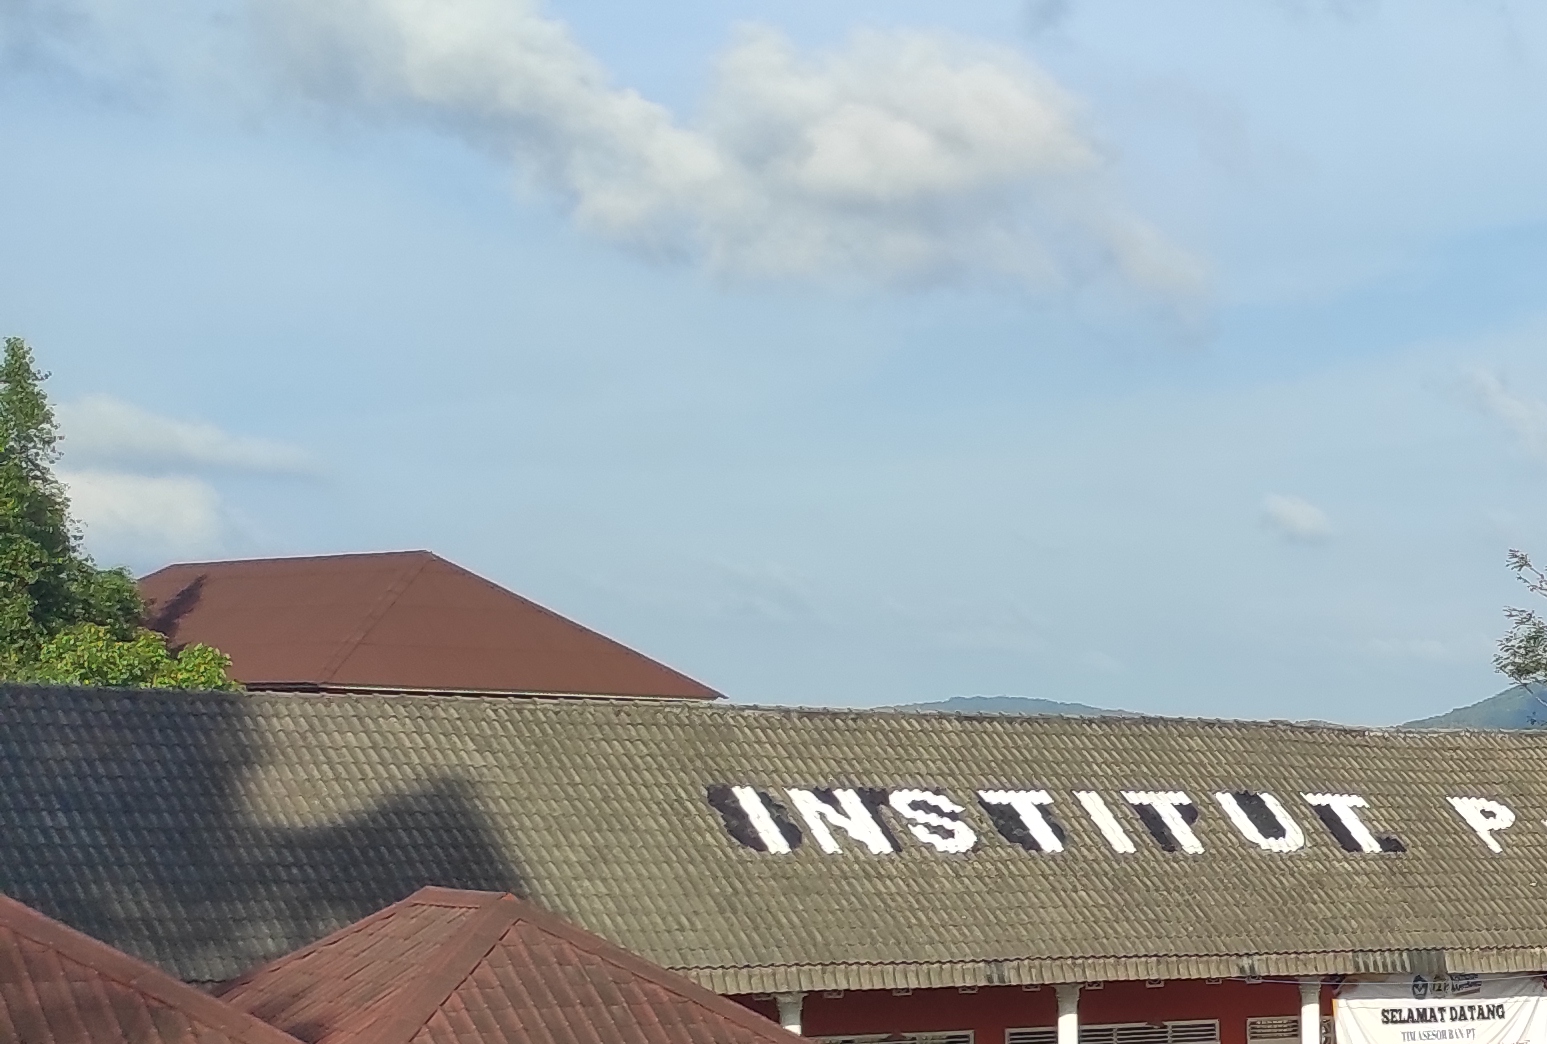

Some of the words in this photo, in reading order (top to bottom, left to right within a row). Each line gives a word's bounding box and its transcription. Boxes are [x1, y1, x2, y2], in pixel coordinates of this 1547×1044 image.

[728, 785, 1394, 855] INSTITUT
[1381, 1006, 1446, 1025] SELAMAT
[1450, 1003, 1505, 1022] DATANG
